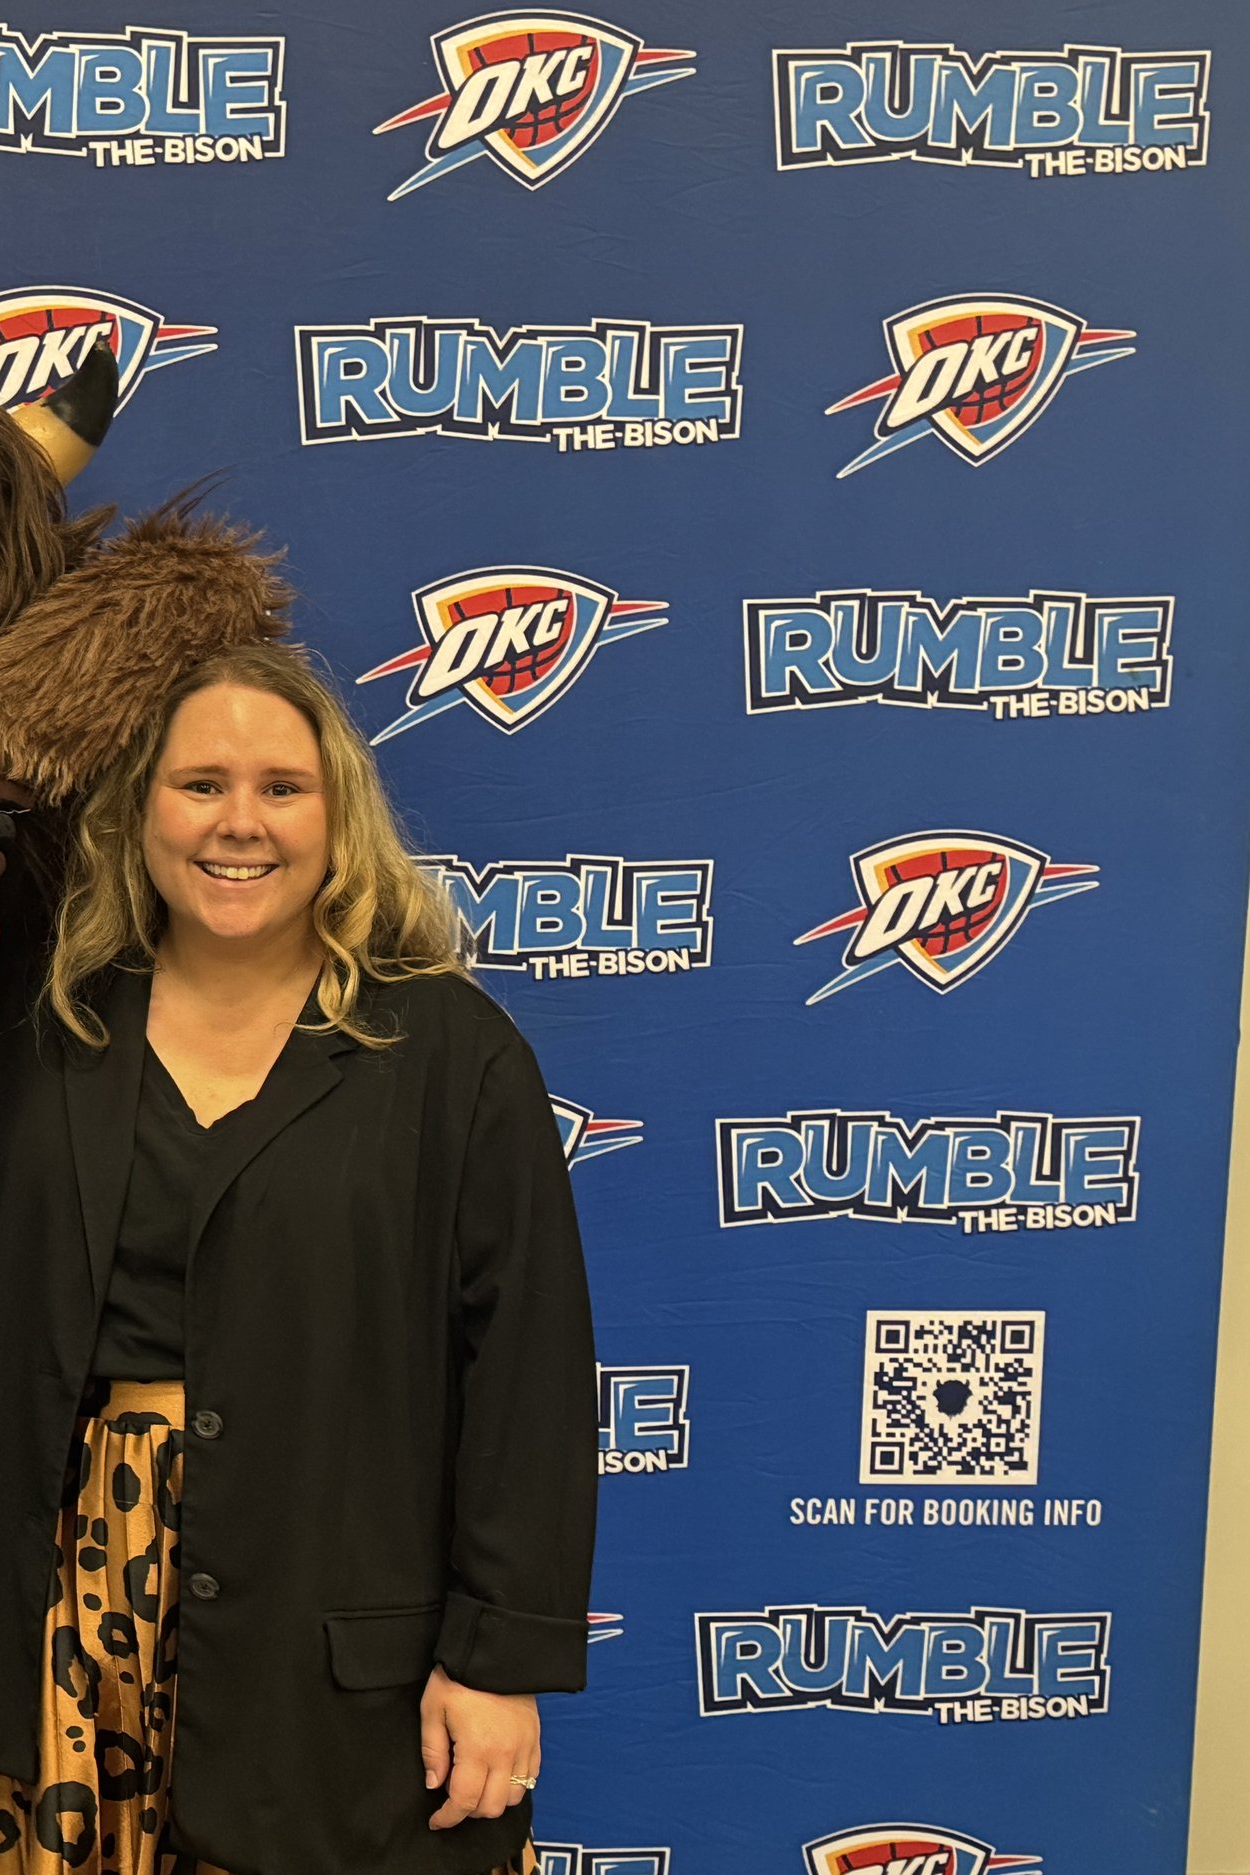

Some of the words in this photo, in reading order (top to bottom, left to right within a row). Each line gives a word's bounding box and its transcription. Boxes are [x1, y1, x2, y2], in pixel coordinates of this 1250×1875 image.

[437, 46, 593, 149] OKC
[788, 52, 1199, 153] RUMBLE
[311, 328, 731, 428] RUMBLE
[888, 328, 1039, 416] OKC
[418, 600, 569, 697] OKC
[759, 600, 1163, 697] RUMBLE
[438, 865, 702, 955] MBLE
[855, 863, 1002, 958] OKC
[731, 1120, 1129, 1211] RUMBLE
[790, 1498, 855, 1525] SCAN
[864, 1498, 914, 1526] FOR
[923, 1498, 1034, 1526] BOOKING
[1044, 1499, 1102, 1526] INFO
[710, 1615, 1100, 1701] RUMBLE
